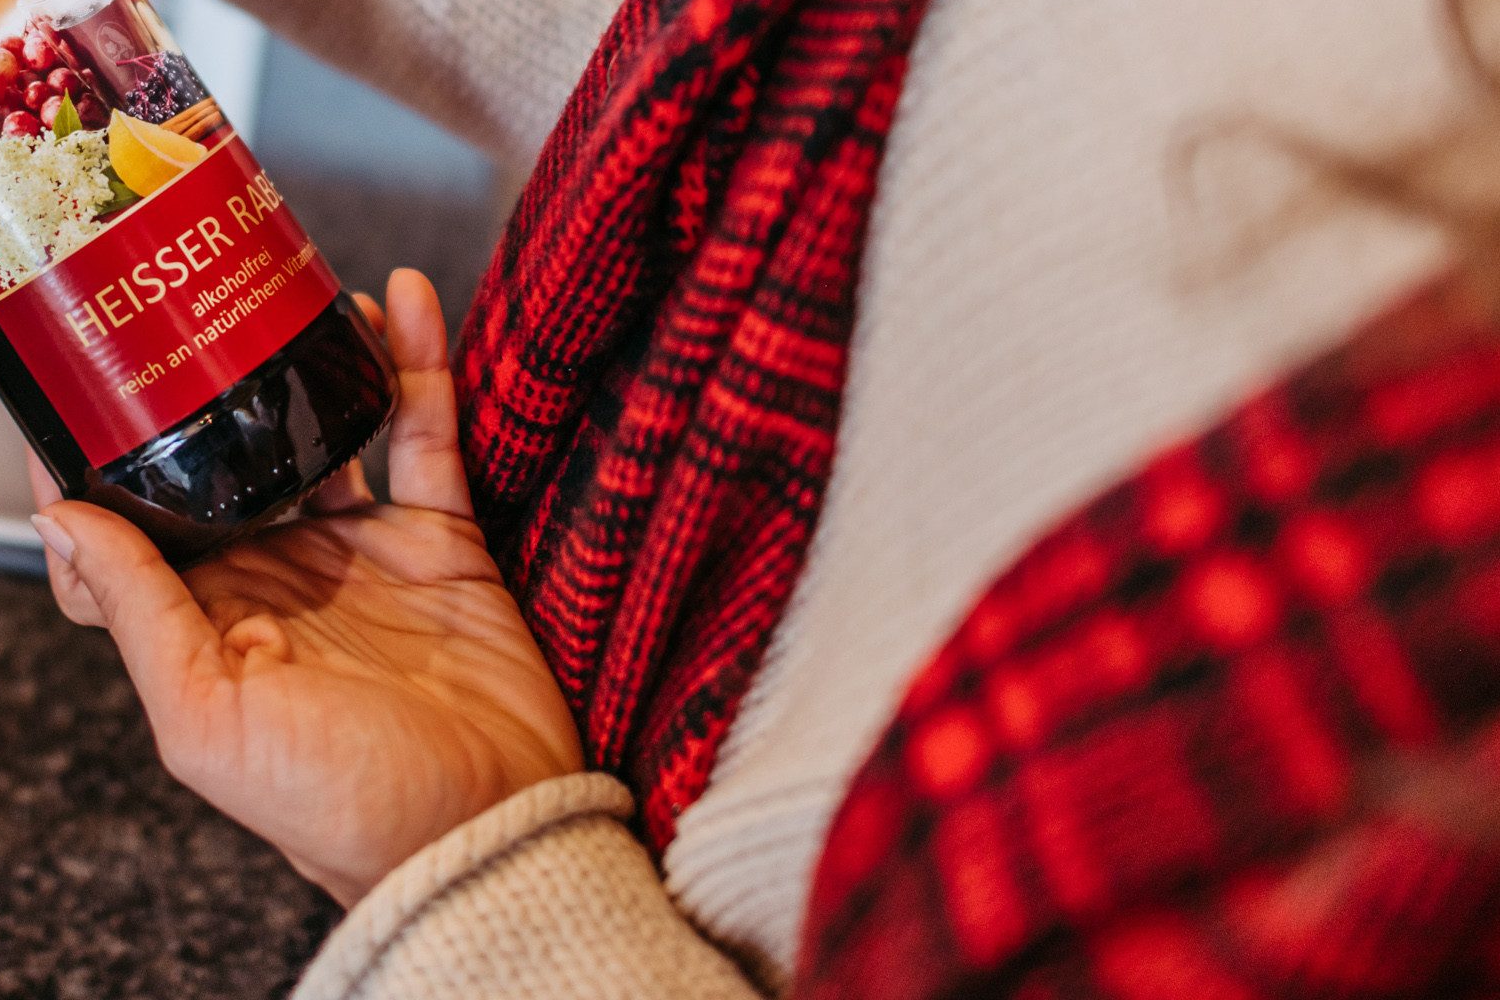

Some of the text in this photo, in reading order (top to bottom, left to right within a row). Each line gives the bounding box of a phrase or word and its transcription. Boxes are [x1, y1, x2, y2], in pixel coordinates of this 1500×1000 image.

[65, 215, 235, 348] HEISSER
[117, 361, 166, 400] reich
[166, 343, 193, 369] an
[192, 272, 287, 350] natürlichem
[190, 245, 273, 317] alkoholfrei
